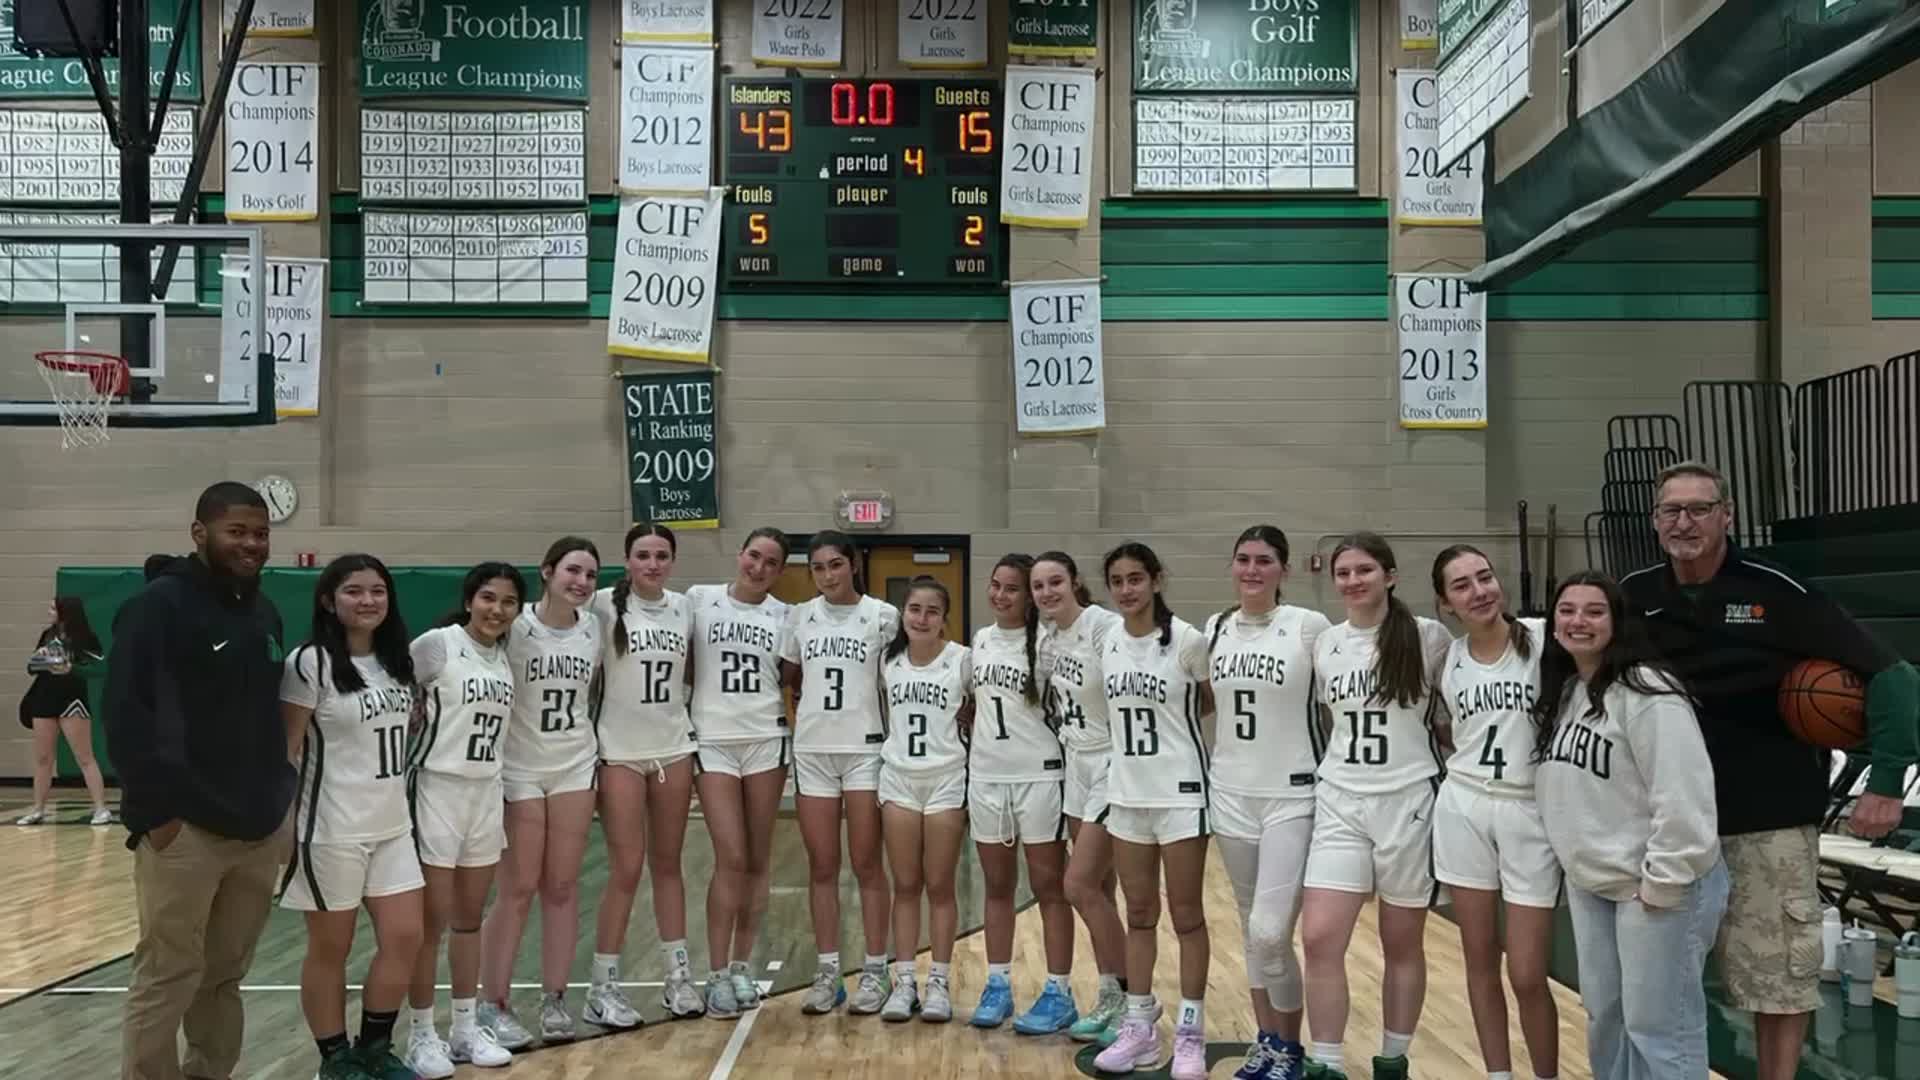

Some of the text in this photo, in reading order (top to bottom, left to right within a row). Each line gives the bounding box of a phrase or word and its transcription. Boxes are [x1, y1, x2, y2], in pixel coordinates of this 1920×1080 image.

[270, 12, 306, 27] Tennis
[631, 2, 704, 21] Boys Lacrosse
[443, 5, 583, 40] Football
[1015, 16, 1090, 36] Girls Lacrosse
[1251, 15, 1320, 43] Golf
[1408, 15, 1435, 37] Boy
[784, 24, 810, 40] Girls
[930, 25, 957, 40] Girls
[769, 41, 826, 57] Water Polo
[921, 41, 965, 57] Lacrosse
[638, 54, 694, 82] CIF
[1142, 59, 1350, 86] League Champions
[0, 69, 54, 88] ague
[238, 66, 305, 97] CIF
[365, 64, 583, 91] League Champions
[629, 86, 704, 108] Champions
[731, 86, 791, 104] Islanders
[935, 87, 990, 105] Guests
[1020, 81, 1081, 111] CIF
[831, 83, 894, 125] 0.0
[1272, 103, 1308, 119] 1970
[1316, 103, 1350, 118] 1971
[229, 103, 315, 124] Champions
[365, 113, 402, 129] 1914
[410, 114, 447, 130] 1915
[545, 114, 581, 130] 1918
[455, 115, 492, 131] 1916
[500, 115, 537, 130] 1917
[631, 115, 702, 145] 2012
[740, 110, 792, 151] 43
[1011, 114, 1086, 136] Champions
[959, 112, 992, 153] 15
[1273, 126, 1308, 141] 1973
[1316, 126, 1351, 141] 1993
[16, 138, 53, 152] 1982
[160, 138, 191, 151] 989
[365, 136, 402, 152] 1919
[410, 136, 447, 152] 1921
[455, 136, 492, 152] 1927
[500, 136, 537, 152] 1929
[545, 136, 581, 152] 1930
[231, 141, 313, 173] 2014
[836, 154, 888, 172] period
[904, 148, 923, 175] 4
[1011, 143, 1081, 175] 2011
[1140, 149, 1177, 164] 1999
[1184, 149, 1221, 164] 2002
[1227, 149, 1265, 164] 2003
[1272, 149, 1308, 164] 2004
[1315, 148, 1351, 163] 2011
[1405, 147, 1472, 178] 204
[17, 160, 54, 174] 1995
[62, 160, 99, 174] 1997
[365, 159, 402, 175] 1931
[410, 159, 447, 175] 1932
[455, 159, 492, 175] 1933
[500, 159, 537, 175] 1936
[545, 159, 581, 175] 1941
[628, 158, 702, 176] Boys Lacrosse
[1140, 171, 1177, 185] 2012
[1184, 170, 1221, 185] 2014
[1227, 170, 1265, 185] 2015
[16, 183, 54, 197] 2001
[62, 183, 100, 197] 2002
[365, 181, 402, 197] 1945
[410, 181, 447, 197] 1949
[455, 181, 492, 197] 1951
[500, 181, 537, 197] 1952
[545, 181, 581, 197] 1961
[735, 185, 772, 204] fouls
[836, 188, 888, 203] player
[951, 187, 988, 204] fouls
[1008, 184, 1082, 205] Girls Lacrosse
[1427, 181, 1452, 196] Girls
[242, 193, 305, 213] Boys Golf
[1403, 198, 1475, 216] Cross Country
[412, 217, 450, 232] 1979
[502, 216, 538, 232] 1986
[546, 215, 583, 231] 2000
[636, 201, 704, 237] CIF
[749, 214, 768, 244] 5
[964, 216, 983, 246] 2
[368, 239, 405, 254] 2002
[412, 240, 450, 256] 2006
[458, 240, 496, 256] 2010
[544, 239, 582, 254] 2015
[625, 238, 709, 264] Champions
[368, 261, 407, 277] 2019
[739, 258, 770, 272] won
[843, 258, 883, 275] game
[955, 259, 986, 273] won
[624, 270, 704, 309] 2009
[1408, 277, 1470, 309] CIF
[1027, 295, 1086, 325] CIF
[618, 317, 702, 343] Boys Lacrosse
[1400, 313, 1482, 336] Champions
[1020, 327, 1095, 349] Champions
[1024, 356, 1095, 388] 2012
[1401, 348, 1478, 381] 2013
[626, 382, 713, 418] STATE
[1426, 386, 1456, 401] Girls
[1024, 400, 1097, 417] Girls Lacrosse
[1402, 403, 1482, 420] Cross Country
[651, 419, 712, 442] Ranking
[633, 448, 714, 484] 2009
[660, 487, 690, 505] Boys
[651, 505, 703, 520] Lacrosse
[855, 504, 877, 521] EXIT
[707, 622, 774, 652] ISLANDERS
[525, 655, 592, 685] ISLANDERS
[721, 651, 761, 693] 22
[640, 660, 672, 704] 12
[824, 667, 844, 711] 3
[541, 689, 577, 732] 21
[1455, 681, 1536, 723] ISLANDERS
[991, 696, 1010, 740] 1
[1234, 689, 1256, 741] 5
[466, 712, 503, 762] 23
[908, 713, 927, 757] 2
[1118, 707, 1160, 757] 13
[1343, 711, 1388, 765] 15
[374, 725, 404, 779] 10
[1479, 724, 1508, 780] 4
